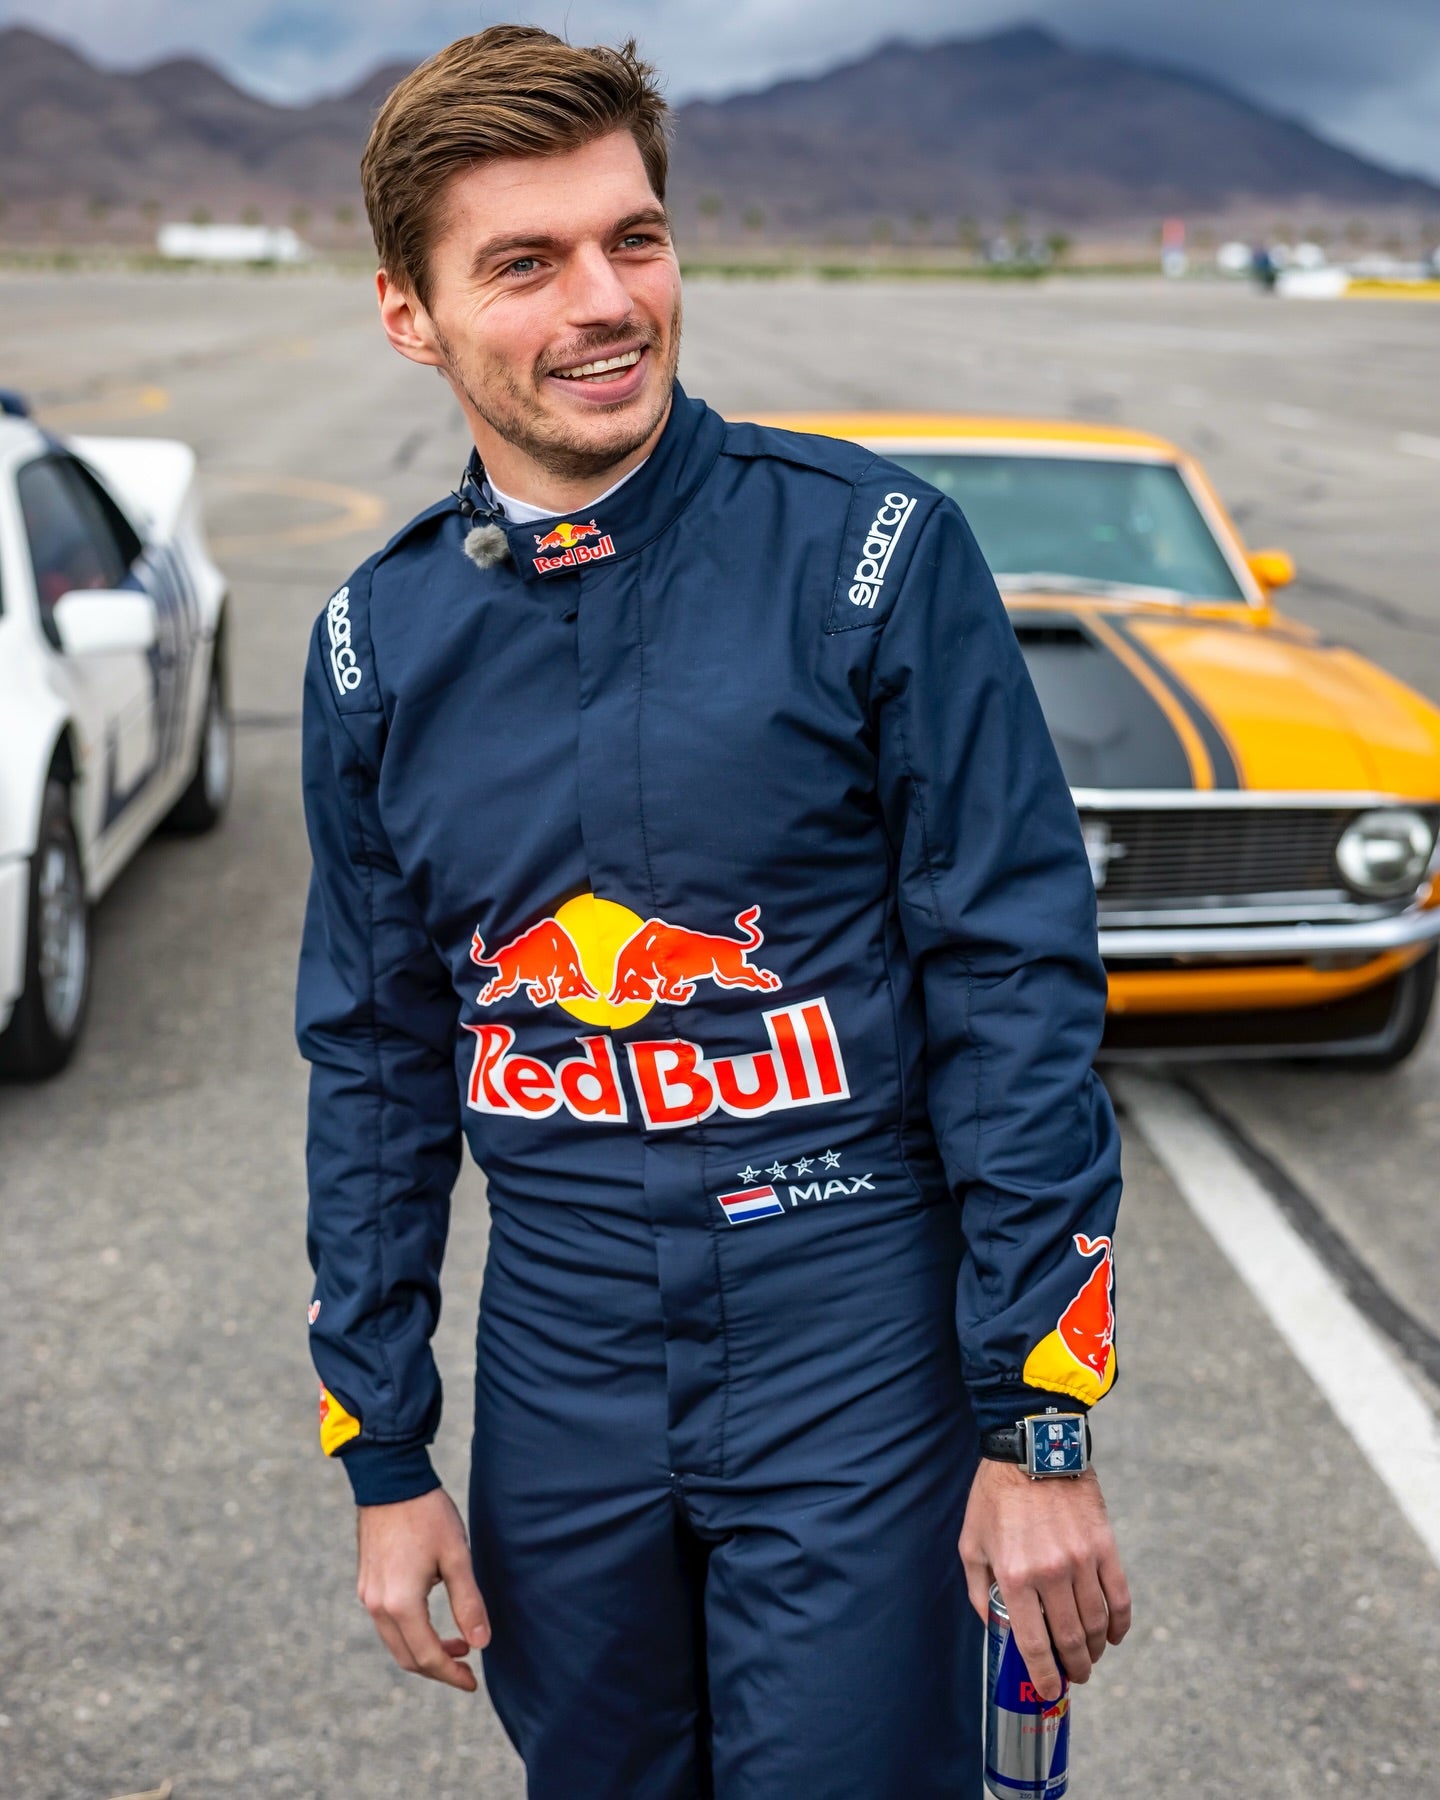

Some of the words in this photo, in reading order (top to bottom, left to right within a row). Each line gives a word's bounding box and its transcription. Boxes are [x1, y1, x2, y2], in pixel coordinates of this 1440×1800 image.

[534, 549, 576, 573] Red
[574, 535, 615, 563] Bull
[848, 493, 917, 608] sparco
[327, 587, 361, 694] sparco
[461, 1023, 627, 1121] Red
[625, 998, 849, 1129] Bull
[788, 1173, 876, 1206] MAX
